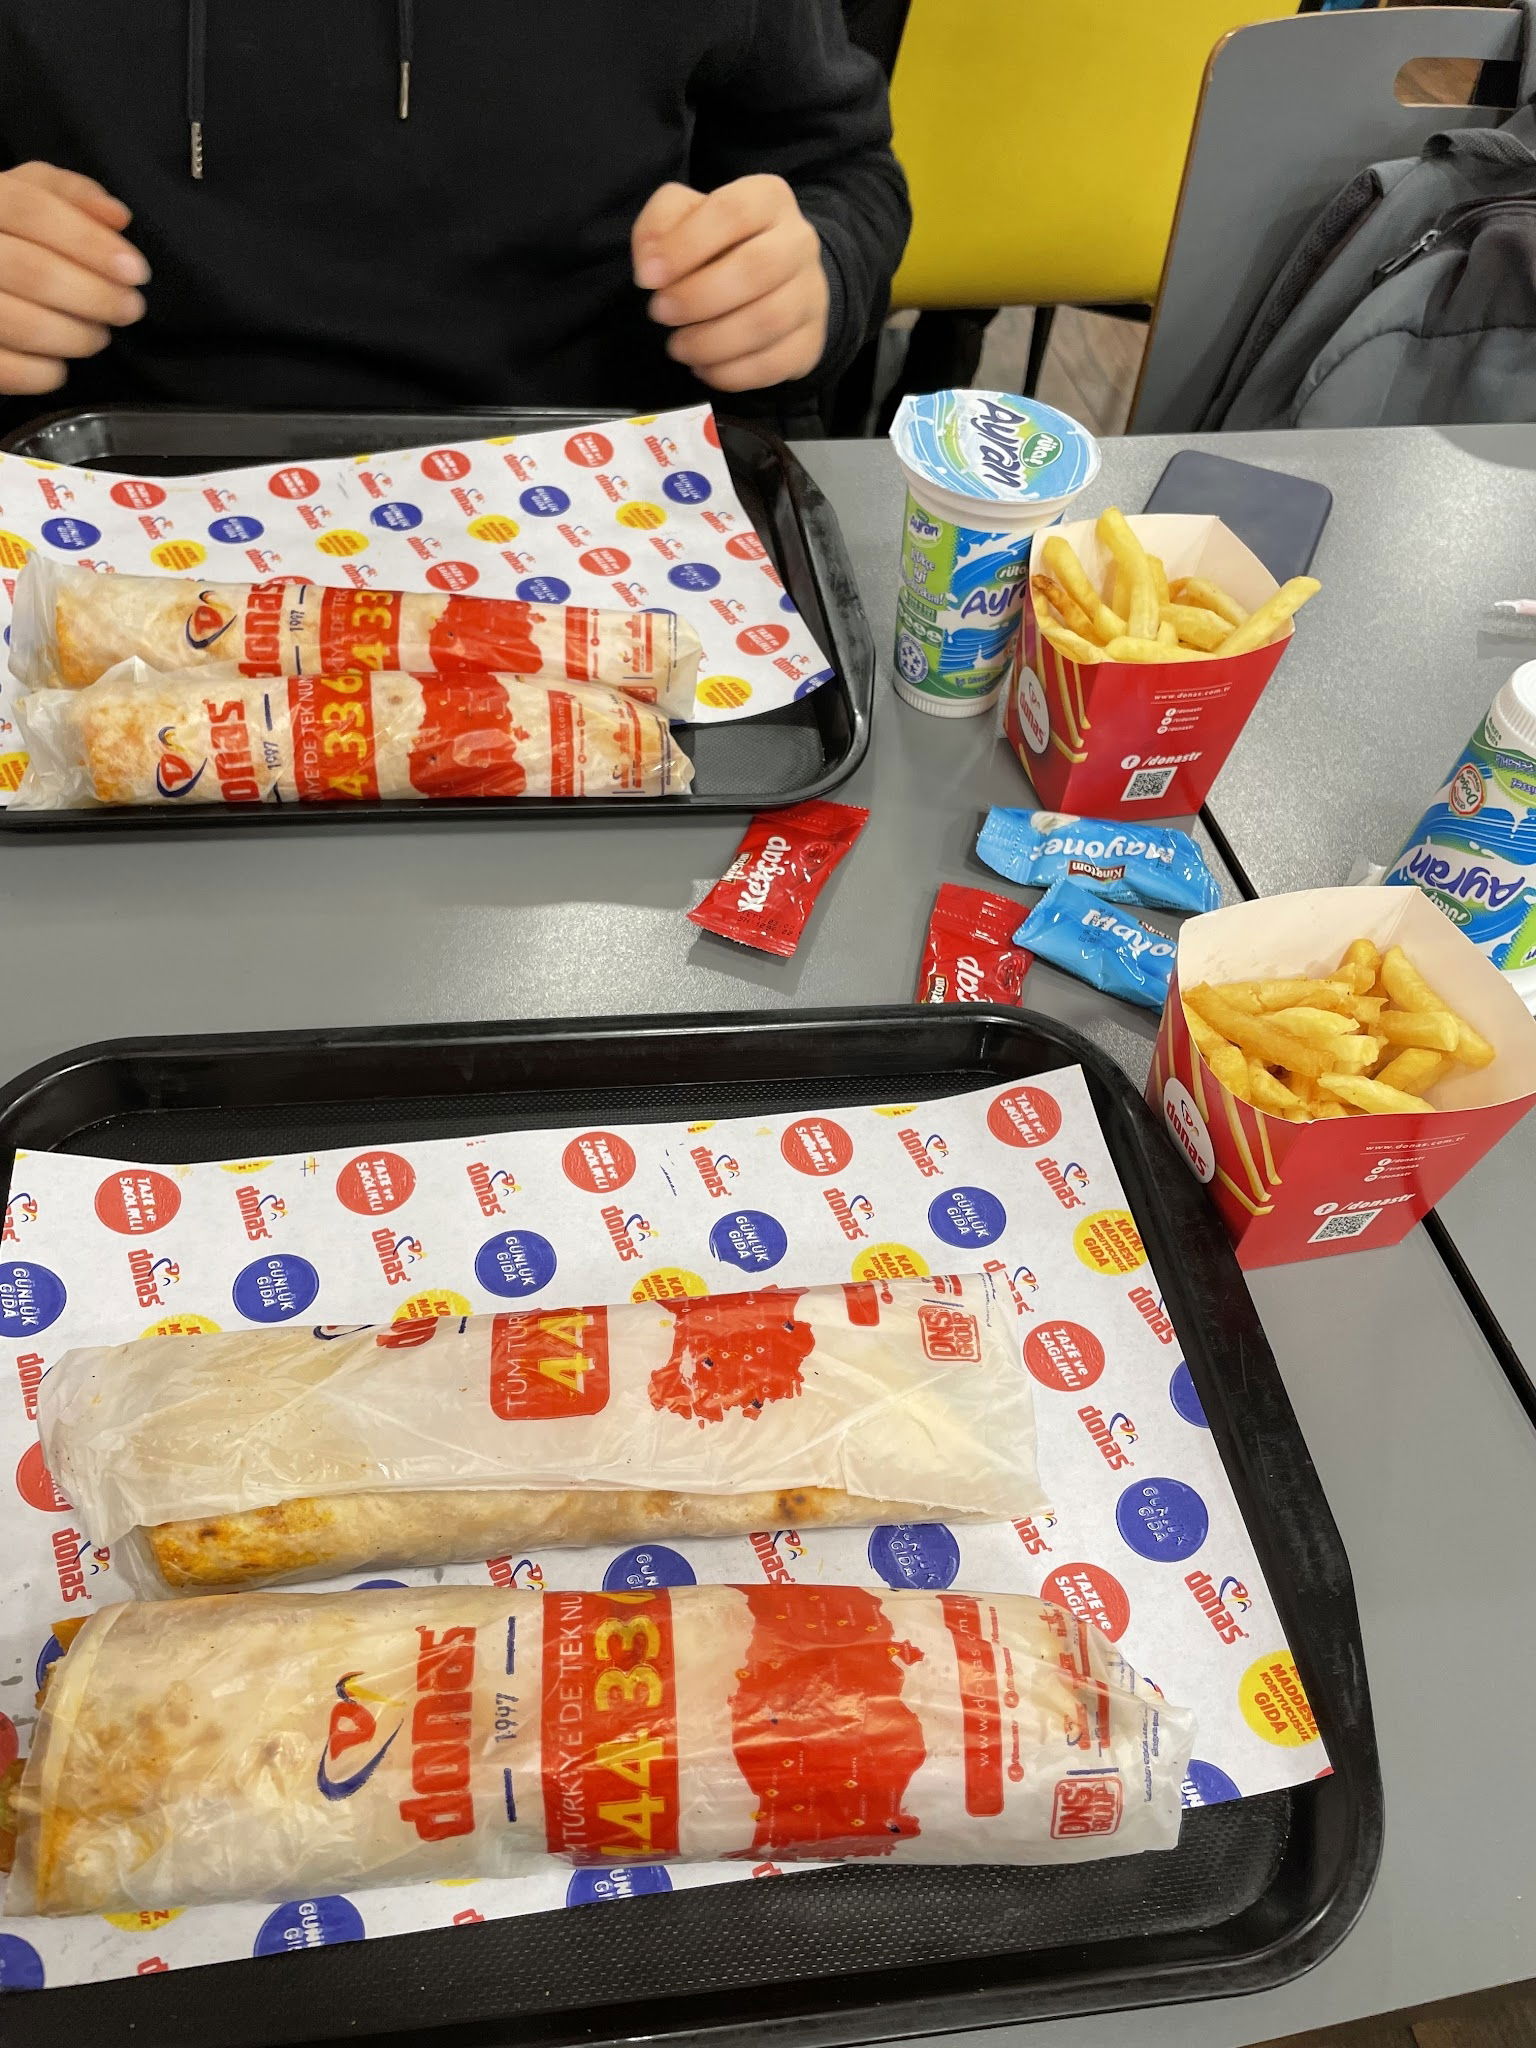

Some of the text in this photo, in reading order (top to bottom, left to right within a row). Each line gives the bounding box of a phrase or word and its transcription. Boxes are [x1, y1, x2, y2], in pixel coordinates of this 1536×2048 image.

[971, 399, 1026, 488] Ayran
[290, 610, 305, 632] 1997
[961, 581, 1026, 619] Ayr
[208, 700, 262, 803] onas
[263, 741, 282, 770] 1997
[1142, 751, 1202, 767] /donastr
[1071, 860, 1124, 879] Kingtom
[1409, 848, 1526, 908] Ayran
[1082, 908, 1177, 959] Mayo
[897, 1129, 939, 1177] donas
[1166, 1099, 1207, 1177] donas
[1365, 1136, 1466, 1151] www.donas.com.tr
[466, 1162, 501, 1217] donas
[690, 1146, 728, 1198] donas
[1035, 1158, 1081, 1209] donas
[235, 1186, 267, 1240] donas
[823, 1188, 865, 1240] donas
[947, 1208, 969, 1235] GIDA
[952, 1193, 990, 1238] GÜNLÜK
[1340, 1193, 1416, 1212] /donastr
[372, 1228, 406, 1285] donas
[601, 1205, 639, 1261] donas
[728, 1230, 751, 1259] GIDA
[736, 1215, 770, 1262] GÜNLÜK
[1083, 1237, 1110, 1267] GIDA
[1097, 1219, 1141, 1268] MADDESİZ
[128, 1249, 159, 1308] donas
[268, 1260, 295, 1311] GÜNLÜK
[496, 1252, 516, 1282] GIDA
[505, 1236, 535, 1286] GÜNLÜK
[1, 1284, 20, 1318] GIDA
[13, 1268, 40, 1326] GÜNLÜK
[256, 1277, 275, 1307] GIDA
[1127, 1286, 1177, 1345] donas
[1036, 1331, 1080, 1387] SAĞLIKLI
[1053, 1329, 1081, 1359] TAZE
[506, 1356, 529, 1410] TÜM
[1078, 1405, 1131, 1471] donas
[52, 1528, 88, 1602] donas
[1073, 1572, 1113, 1630] TAZE ve
[1184, 1570, 1246, 1645] donas
[560, 1627, 583, 1671] TEK
[594, 1615, 663, 1712] 33
[400, 1626, 477, 1842] donas
[495, 1692, 519, 1743] 1997
[1254, 1691, 1288, 1735] GIDA
[559, 1688, 587, 1839] TÜRKİYE'DE
[1059, 1786, 1093, 1836] DNS
